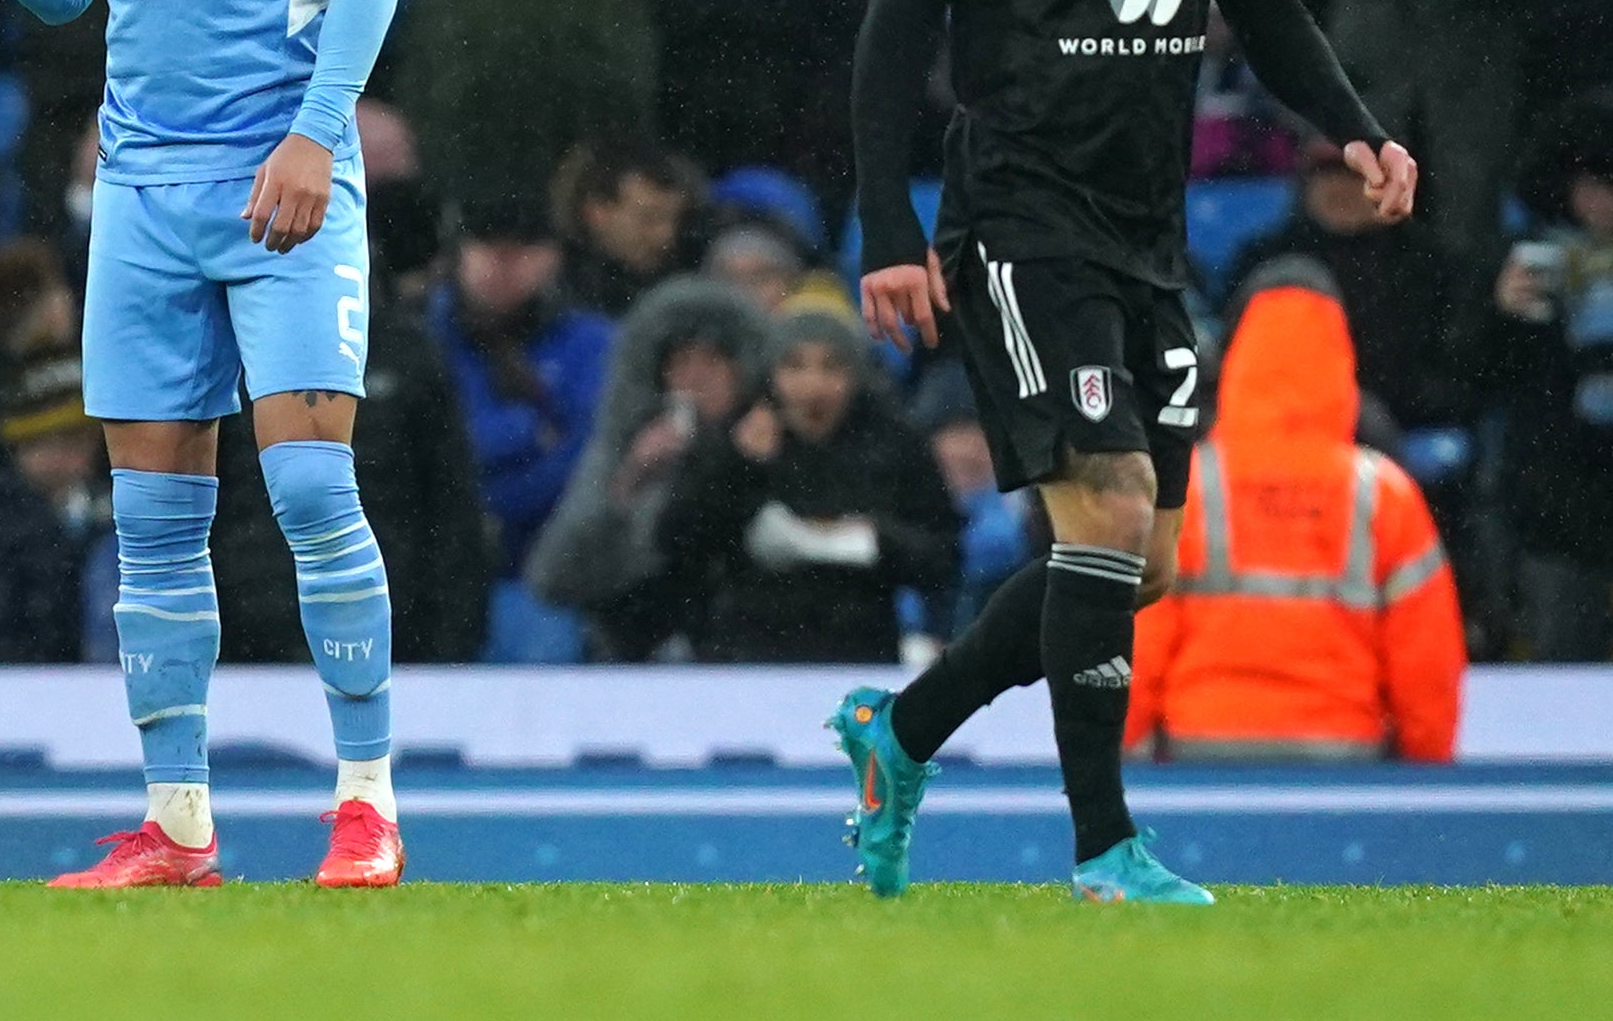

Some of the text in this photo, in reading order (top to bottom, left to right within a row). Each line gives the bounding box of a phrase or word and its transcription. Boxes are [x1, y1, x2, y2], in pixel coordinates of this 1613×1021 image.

[1058, 37, 1147, 55] WORLD
[1157, 347, 1200, 428] 2
[323, 638, 373, 662] CITY
